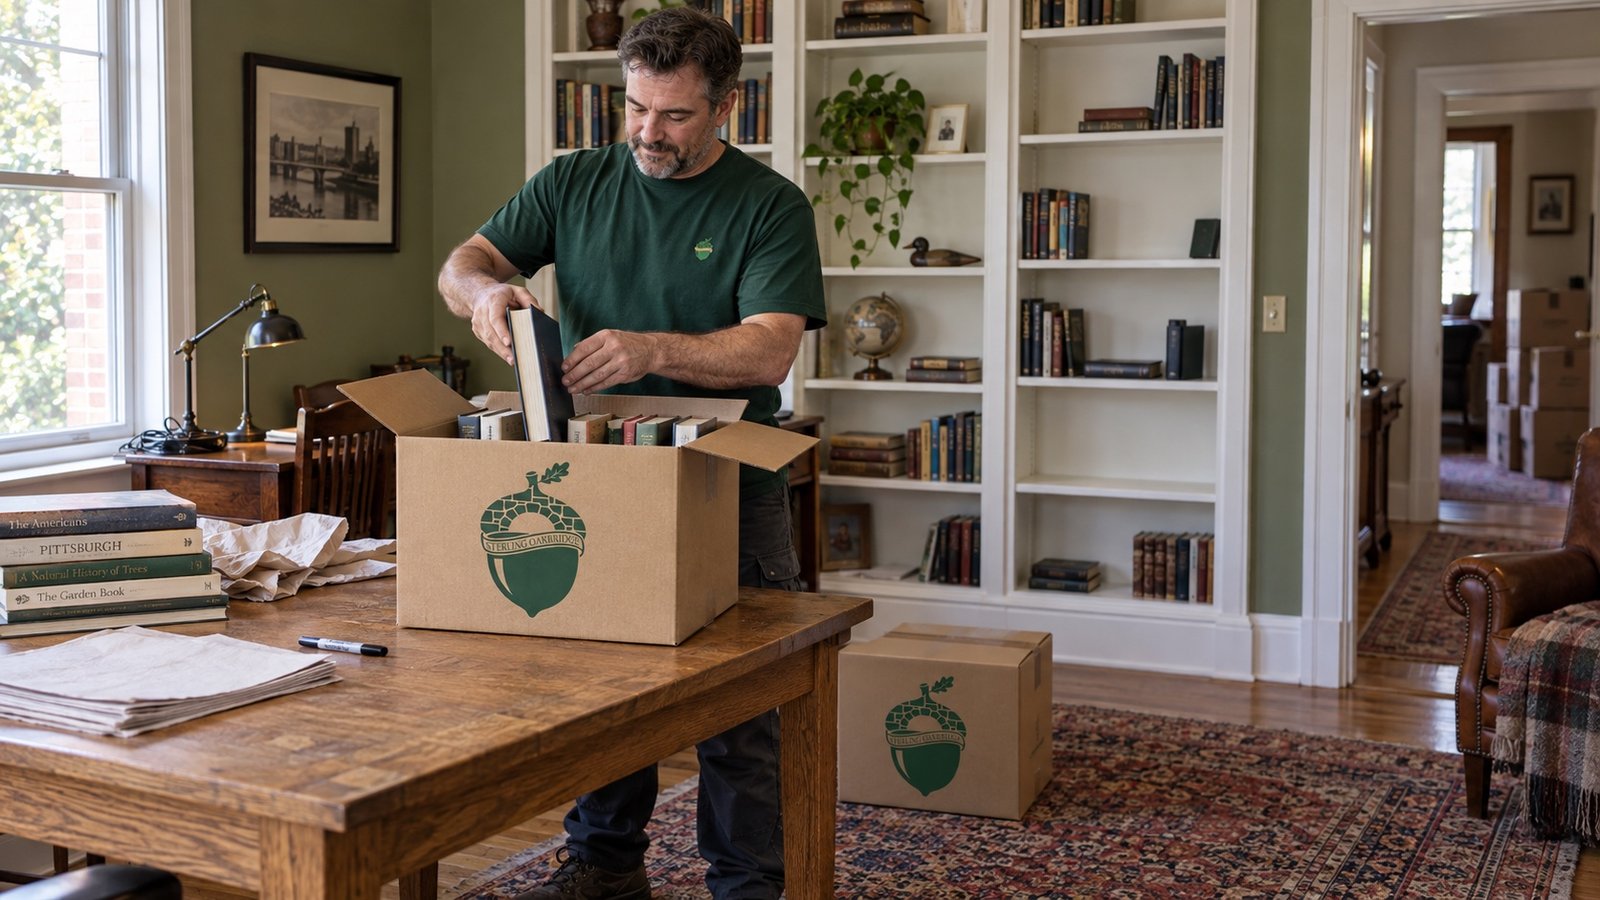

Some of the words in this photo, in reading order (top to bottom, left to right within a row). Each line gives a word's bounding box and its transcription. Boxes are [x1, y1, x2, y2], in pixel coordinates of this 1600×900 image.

[9, 519, 29, 530] The
[31, 517, 88, 529] Americans
[40, 541, 121, 555] PITTSBURGH
[486, 539, 527, 551] STERLING
[19, 572, 28, 582] A
[31, 568, 69, 581] Natural
[72, 567, 108, 578] History
[110, 565, 120, 576] of
[122, 564, 148, 575] Trees
[37, 591, 58, 602] The
[60, 589, 97, 600] Garden
[100, 587, 125, 598] Book
